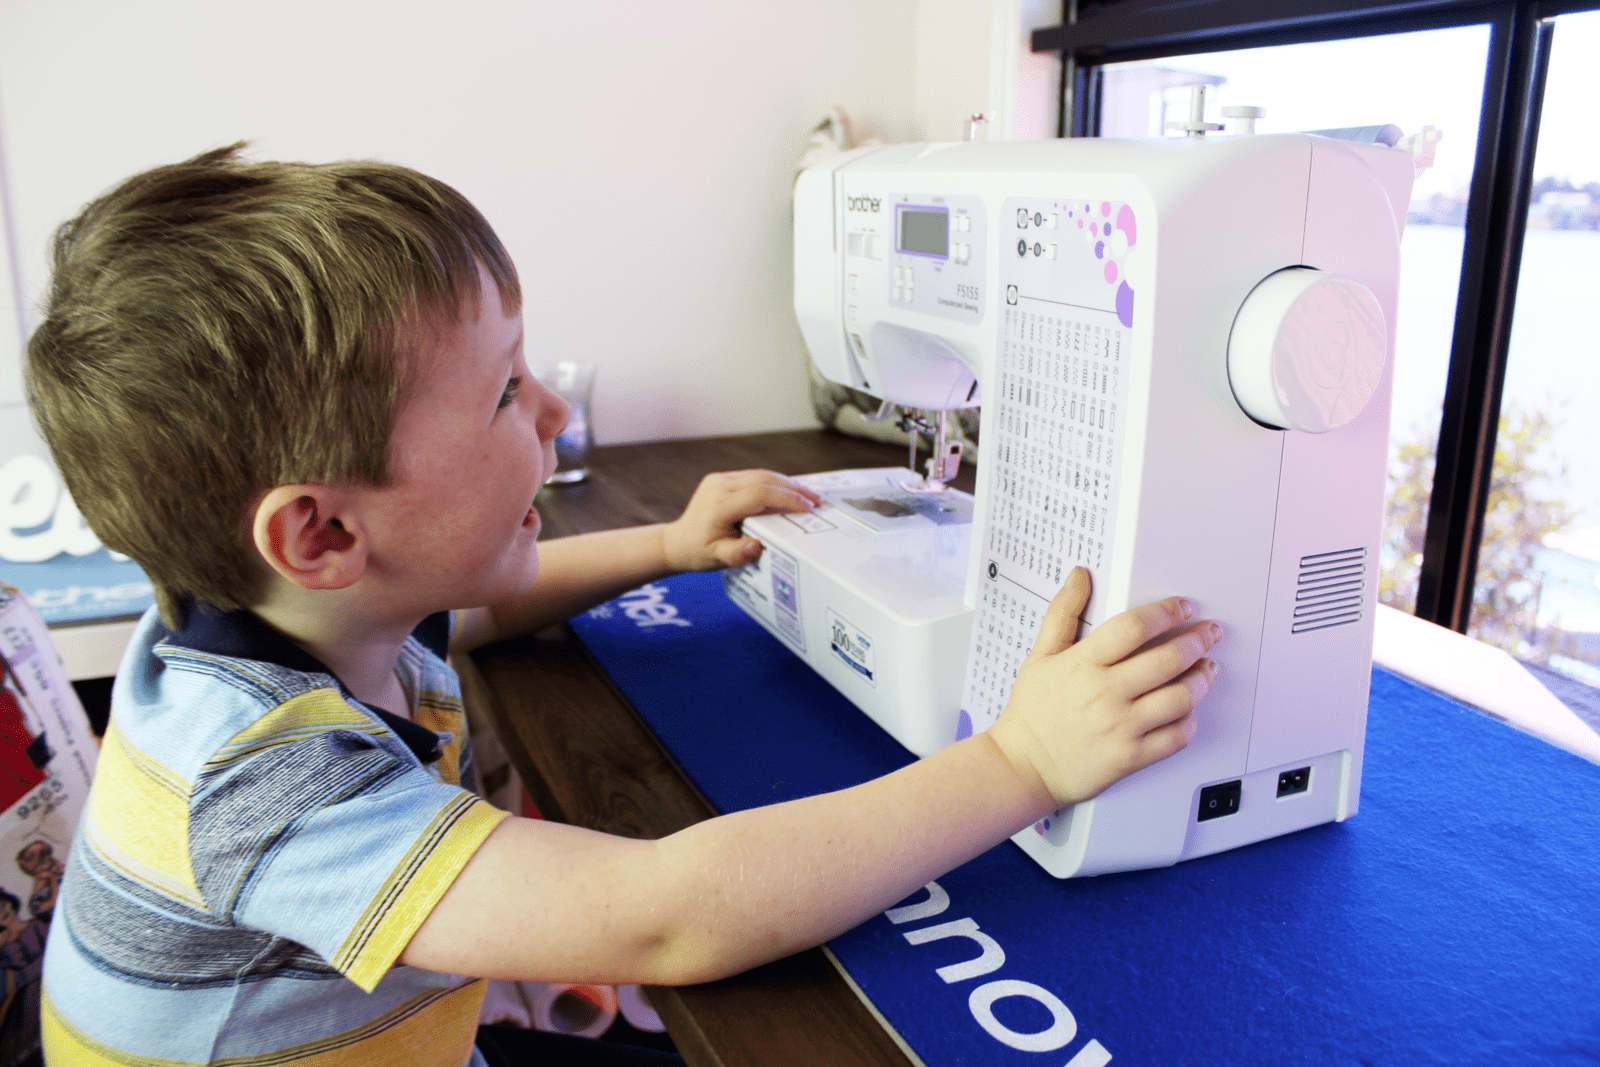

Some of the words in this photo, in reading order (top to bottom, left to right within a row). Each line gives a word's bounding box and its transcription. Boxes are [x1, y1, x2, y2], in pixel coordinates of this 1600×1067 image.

[848, 194, 882, 213] brother
[957, 284, 979, 300] FS155
[831, 625, 850, 651] 100
[884, 880, 1113, 1067] nno
